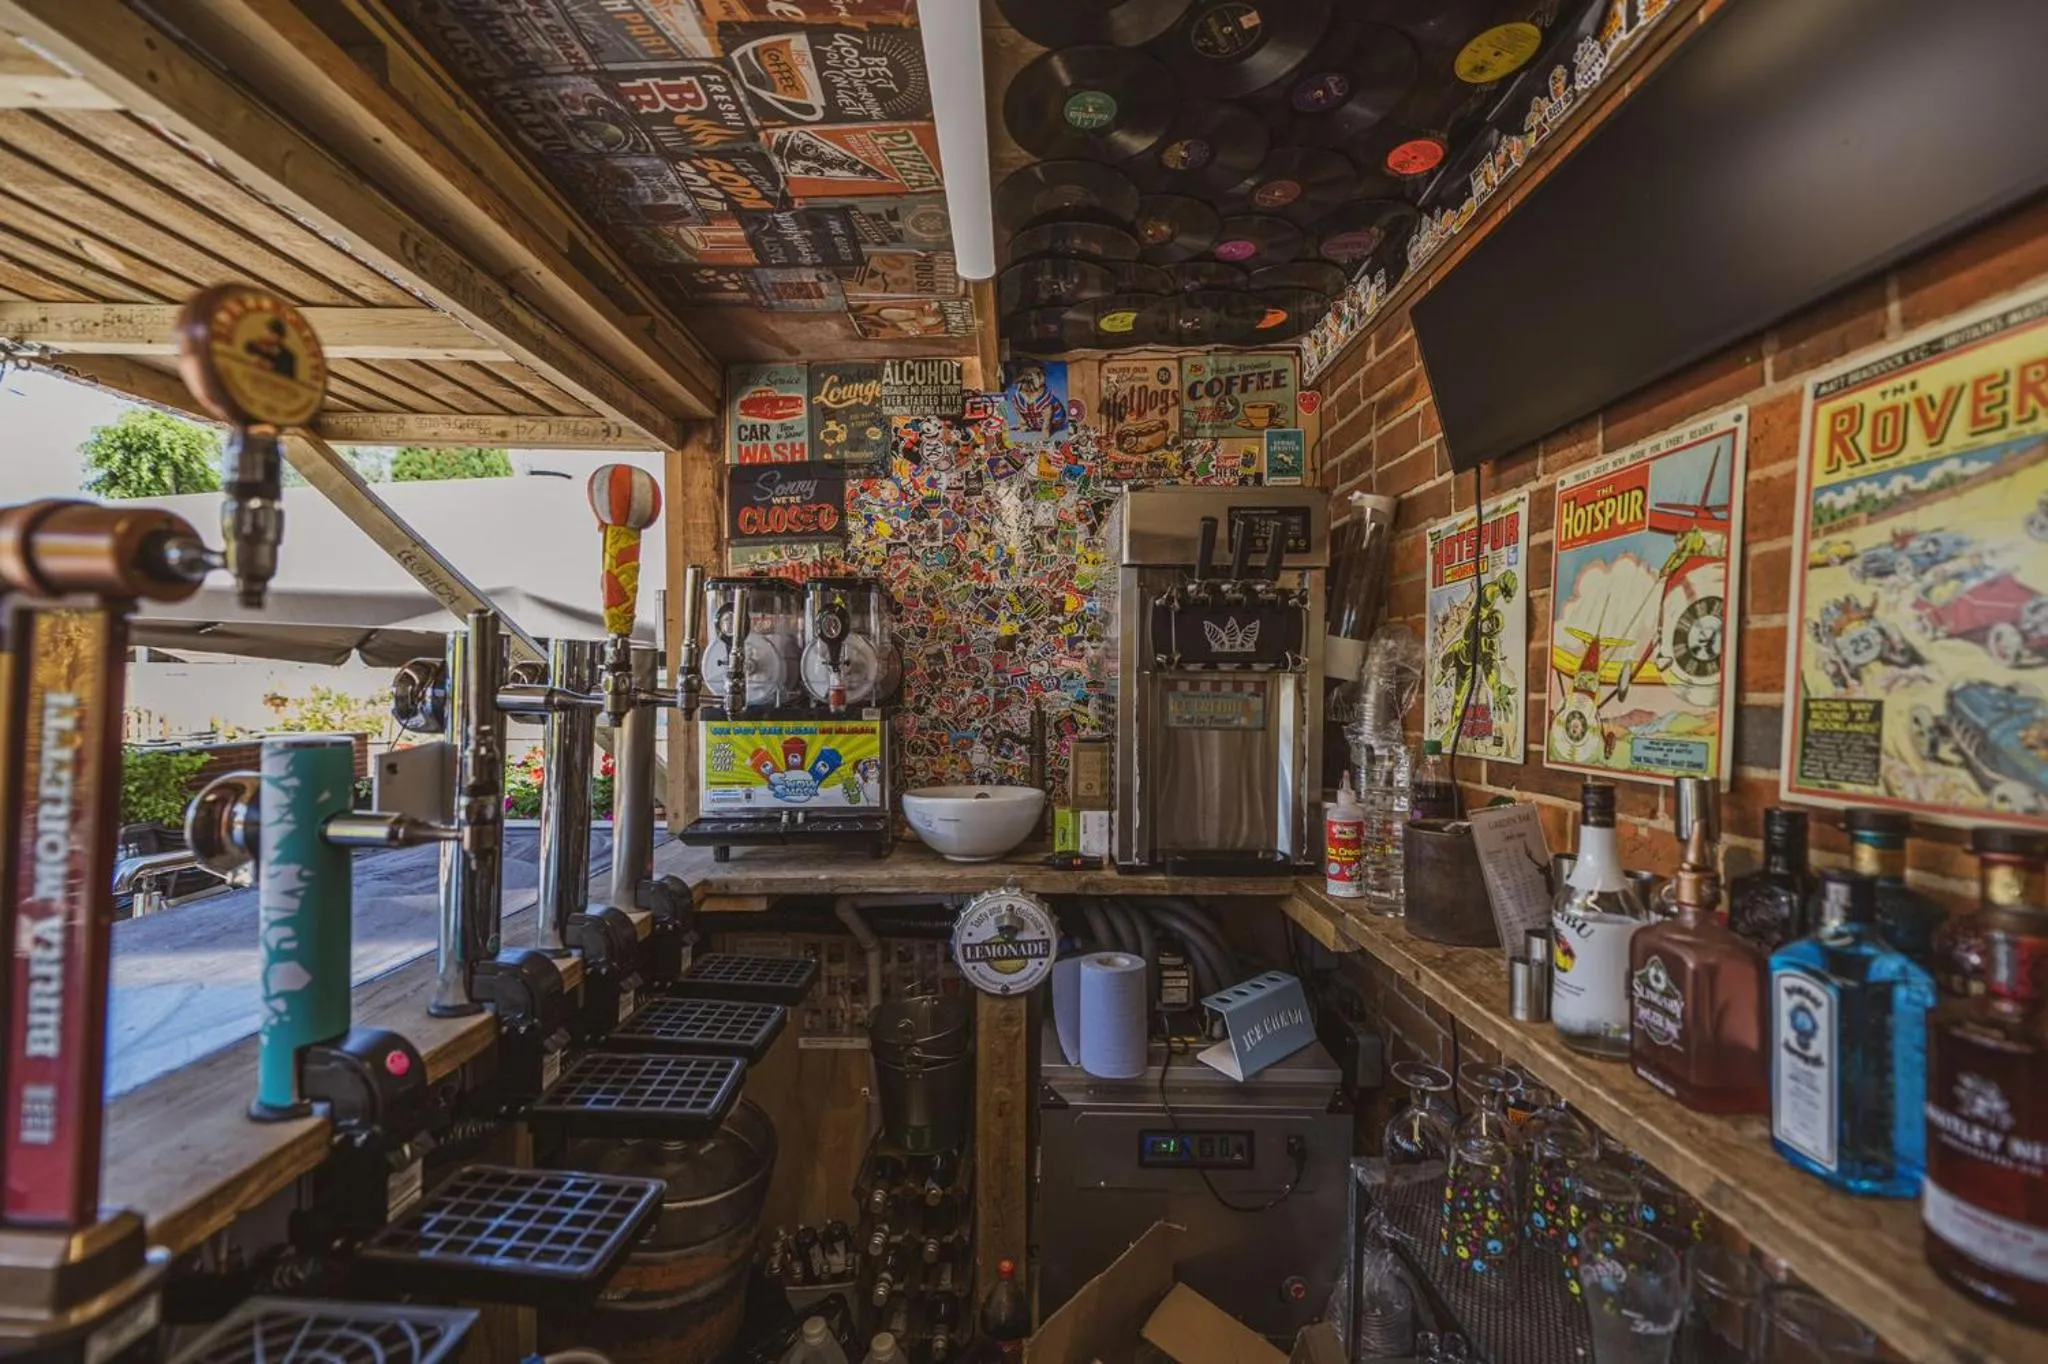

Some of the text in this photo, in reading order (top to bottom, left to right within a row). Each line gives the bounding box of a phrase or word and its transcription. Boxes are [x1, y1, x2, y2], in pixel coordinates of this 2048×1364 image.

[760, 48, 801, 93] COFFEE
[816, 44, 840, 74] YOU
[862, 56, 898, 92] BEST
[822, 69, 845, 96] CAN
[833, 33, 868, 84] GOOD
[852, 78, 889, 121] MORNING
[701, 74, 745, 127] FRESH!
[882, 359, 962, 386] ALCOHOL
[1188, 368, 1289, 401] COFFEE
[882, 385, 909, 396] BECAUSE
[910, 385, 920, 395] NO
[921, 385, 940, 395] GREAT
[882, 396, 962, 406] EVER STARTED WITH
[1879, 379, 1919, 400] THE
[1824, 357, 2048, 475] ROVER
[738, 424, 770, 441] CAR
[737, 442, 806, 465] WASH
[1597, 484, 1615, 497] THE
[737, 503, 840, 535] CLOSED
[1561, 487, 1646, 541] HOTSPUR
[1851, 635, 1873, 655] 25
[33, 693, 78, 899] MORETTI
[970, 911, 989, 930] Tasty
[966, 939, 1049, 961] LEMONADE
[25, 914, 65, 1060] BIRRA
[1243, 1008, 1305, 1052] ICE CREAM
